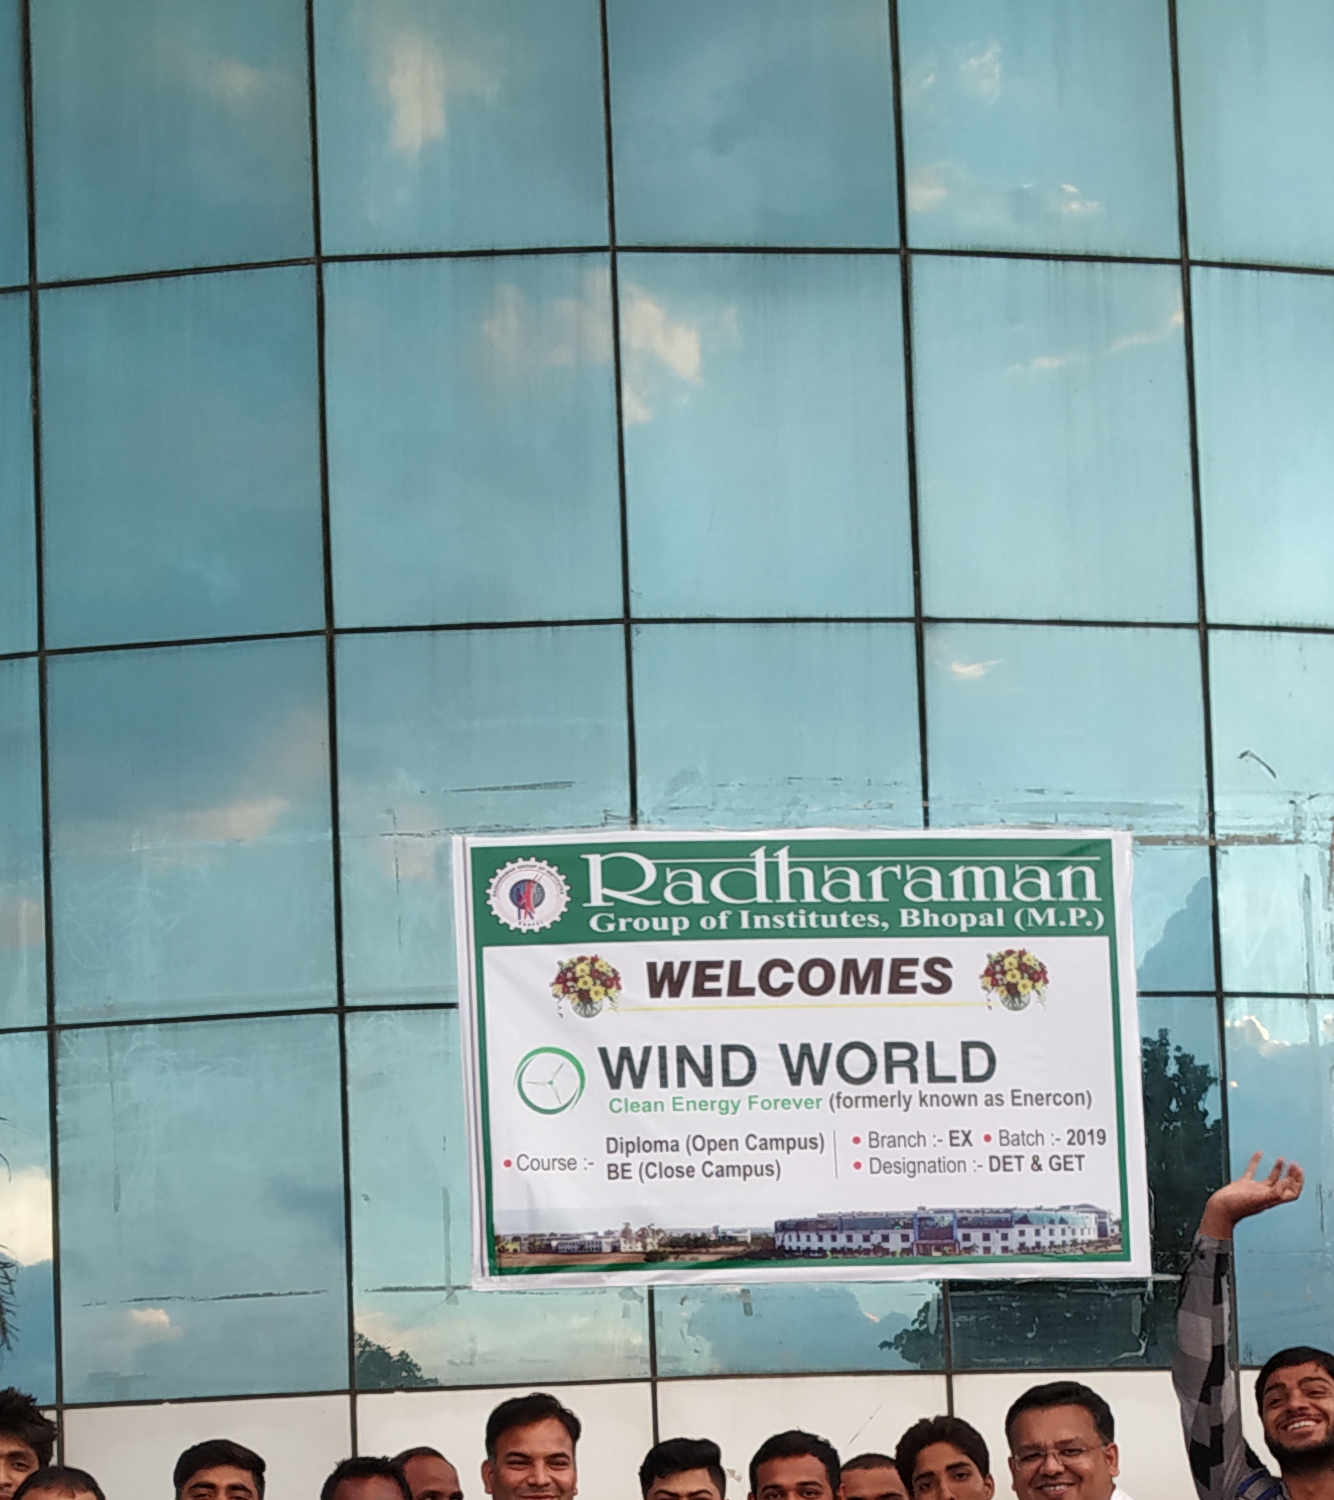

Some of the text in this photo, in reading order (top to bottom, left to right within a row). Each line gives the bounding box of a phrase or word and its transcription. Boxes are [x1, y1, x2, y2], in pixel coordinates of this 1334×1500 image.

[581, 846, 1101, 909] Radharaman
[590, 908, 1104, 935] Group of Institutes, Bhopal (M.P.)
[646, 957, 953, 998] WELCOMES
[598, 1041, 996, 1090] WIND WORLD
[610, 1089, 1091, 1115] Clean Energy Forever (formerly known as Enercon)
[606, 1133, 824, 1157] Diploma (Open Campus)
[869, 1131, 926, 1148] Branch
[949, 1130, 973, 1146] EX
[999, 1130, 1044, 1146] Batch
[1067, 1129, 1106, 1145] 2019
[517, 1154, 576, 1171] Course
[607, 1160, 780, 1183] BE (Close Campus)
[870, 1157, 966, 1178] Designation
[989, 1155, 1024, 1172] DET
[1031, 1155, 1042, 1171] &
[1049, 1155, 1085, 1171] GET
